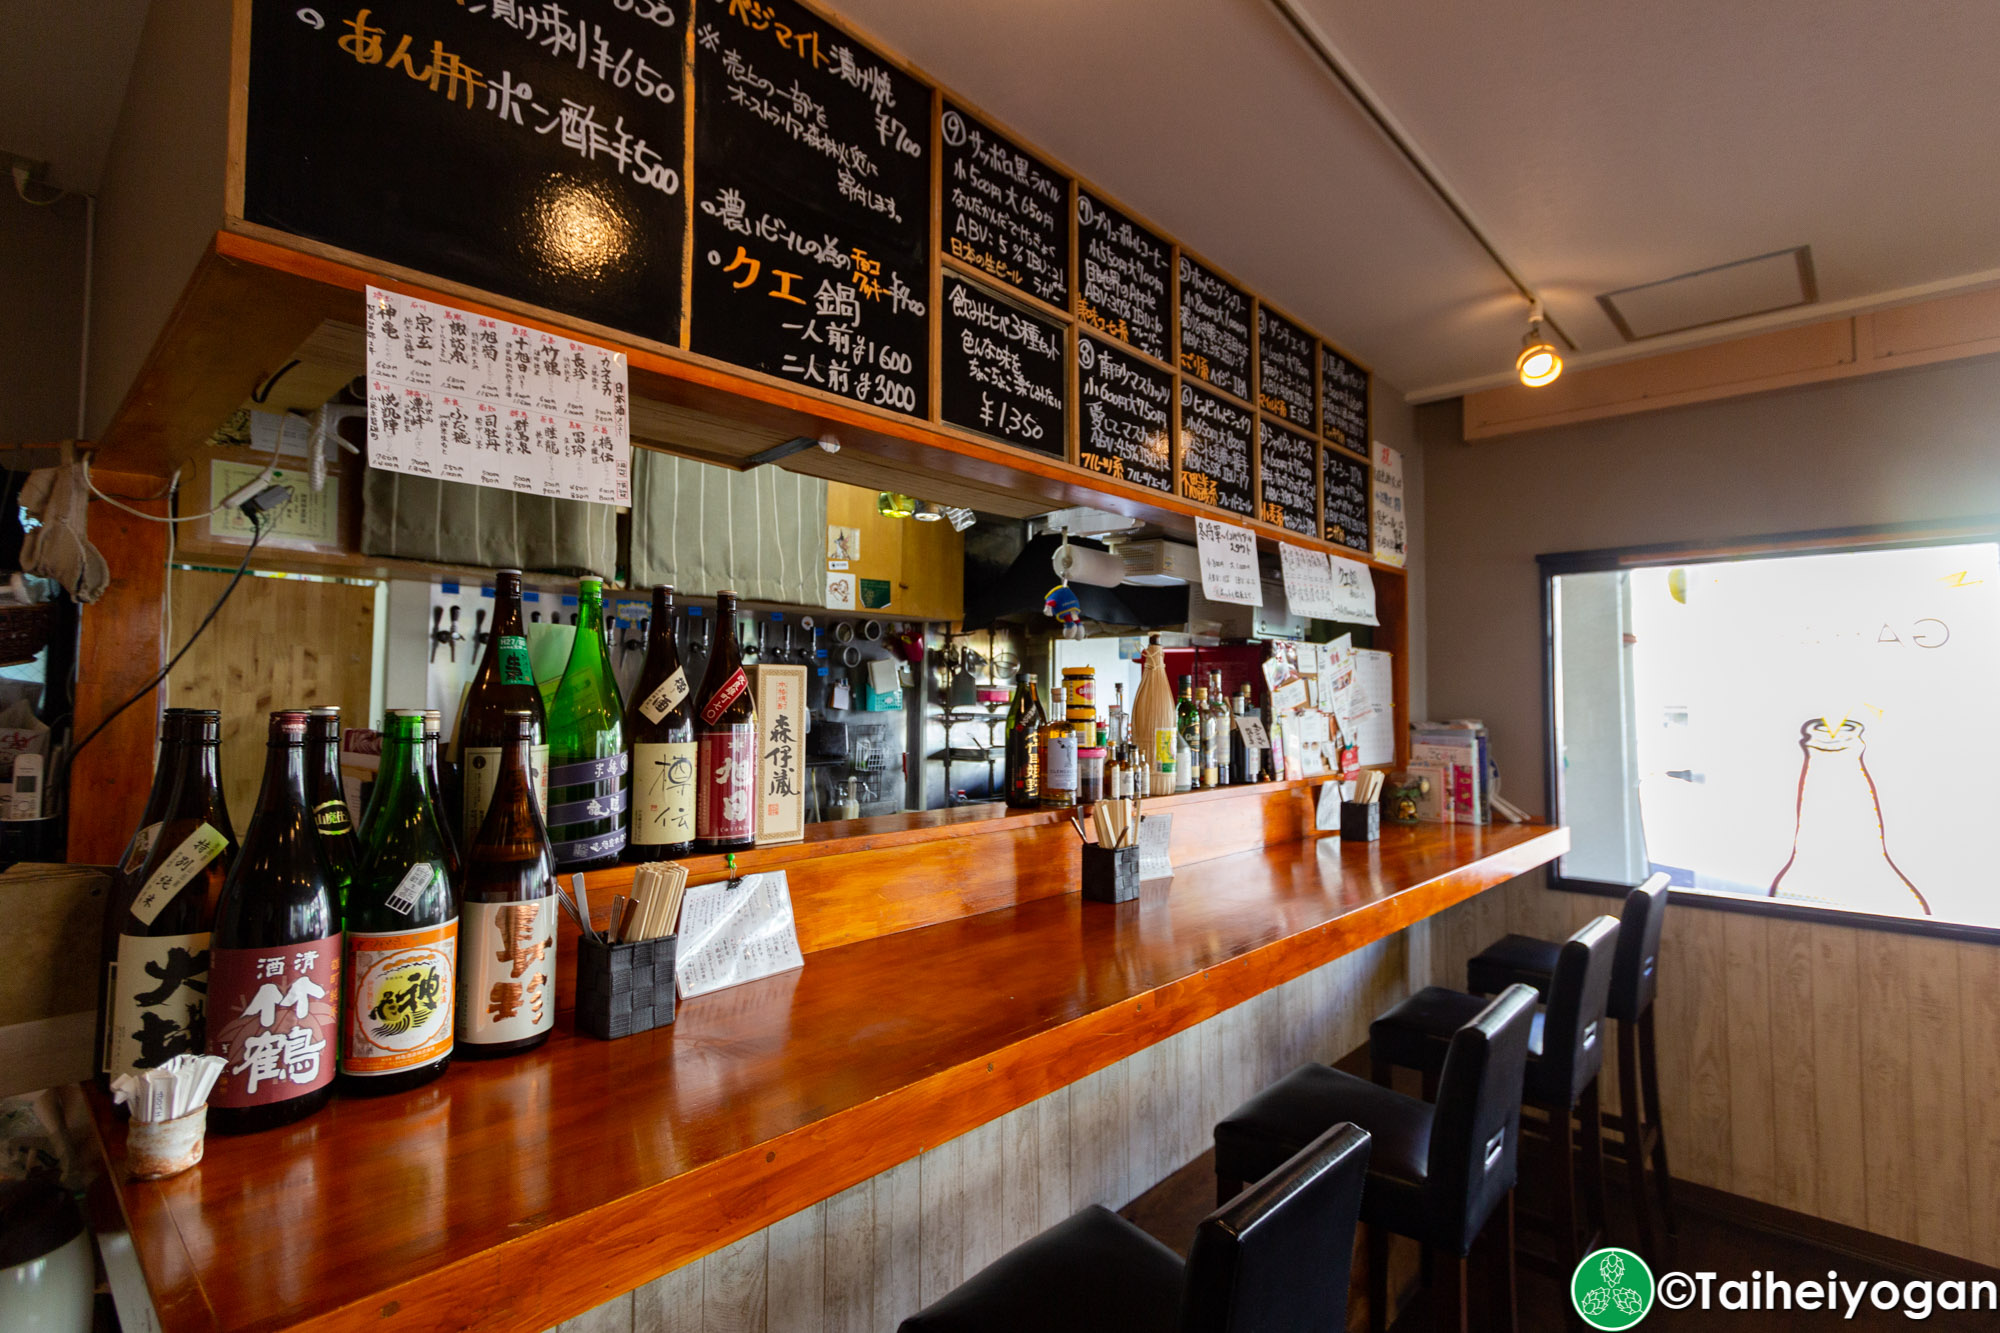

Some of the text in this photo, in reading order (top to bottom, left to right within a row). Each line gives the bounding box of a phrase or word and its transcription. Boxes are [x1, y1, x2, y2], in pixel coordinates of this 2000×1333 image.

[416, 314, 432, 349] 宗玄
[481, 331, 498, 361] 旭菊
[515, 337, 530, 372] 十旭日
[541, 346, 561, 376] 竹鶴
[573, 353, 587, 379] 長珍
[485, 414, 500, 451] 司牡丹
[514, 418, 531, 454] 群馬泉
[764, 714, 801, 798] 森伊蔵
[649, 754, 693, 830] 樽伝
[486, 904, 553, 1026] 長珍
[233, 976, 327, 1095] 竹鶴
